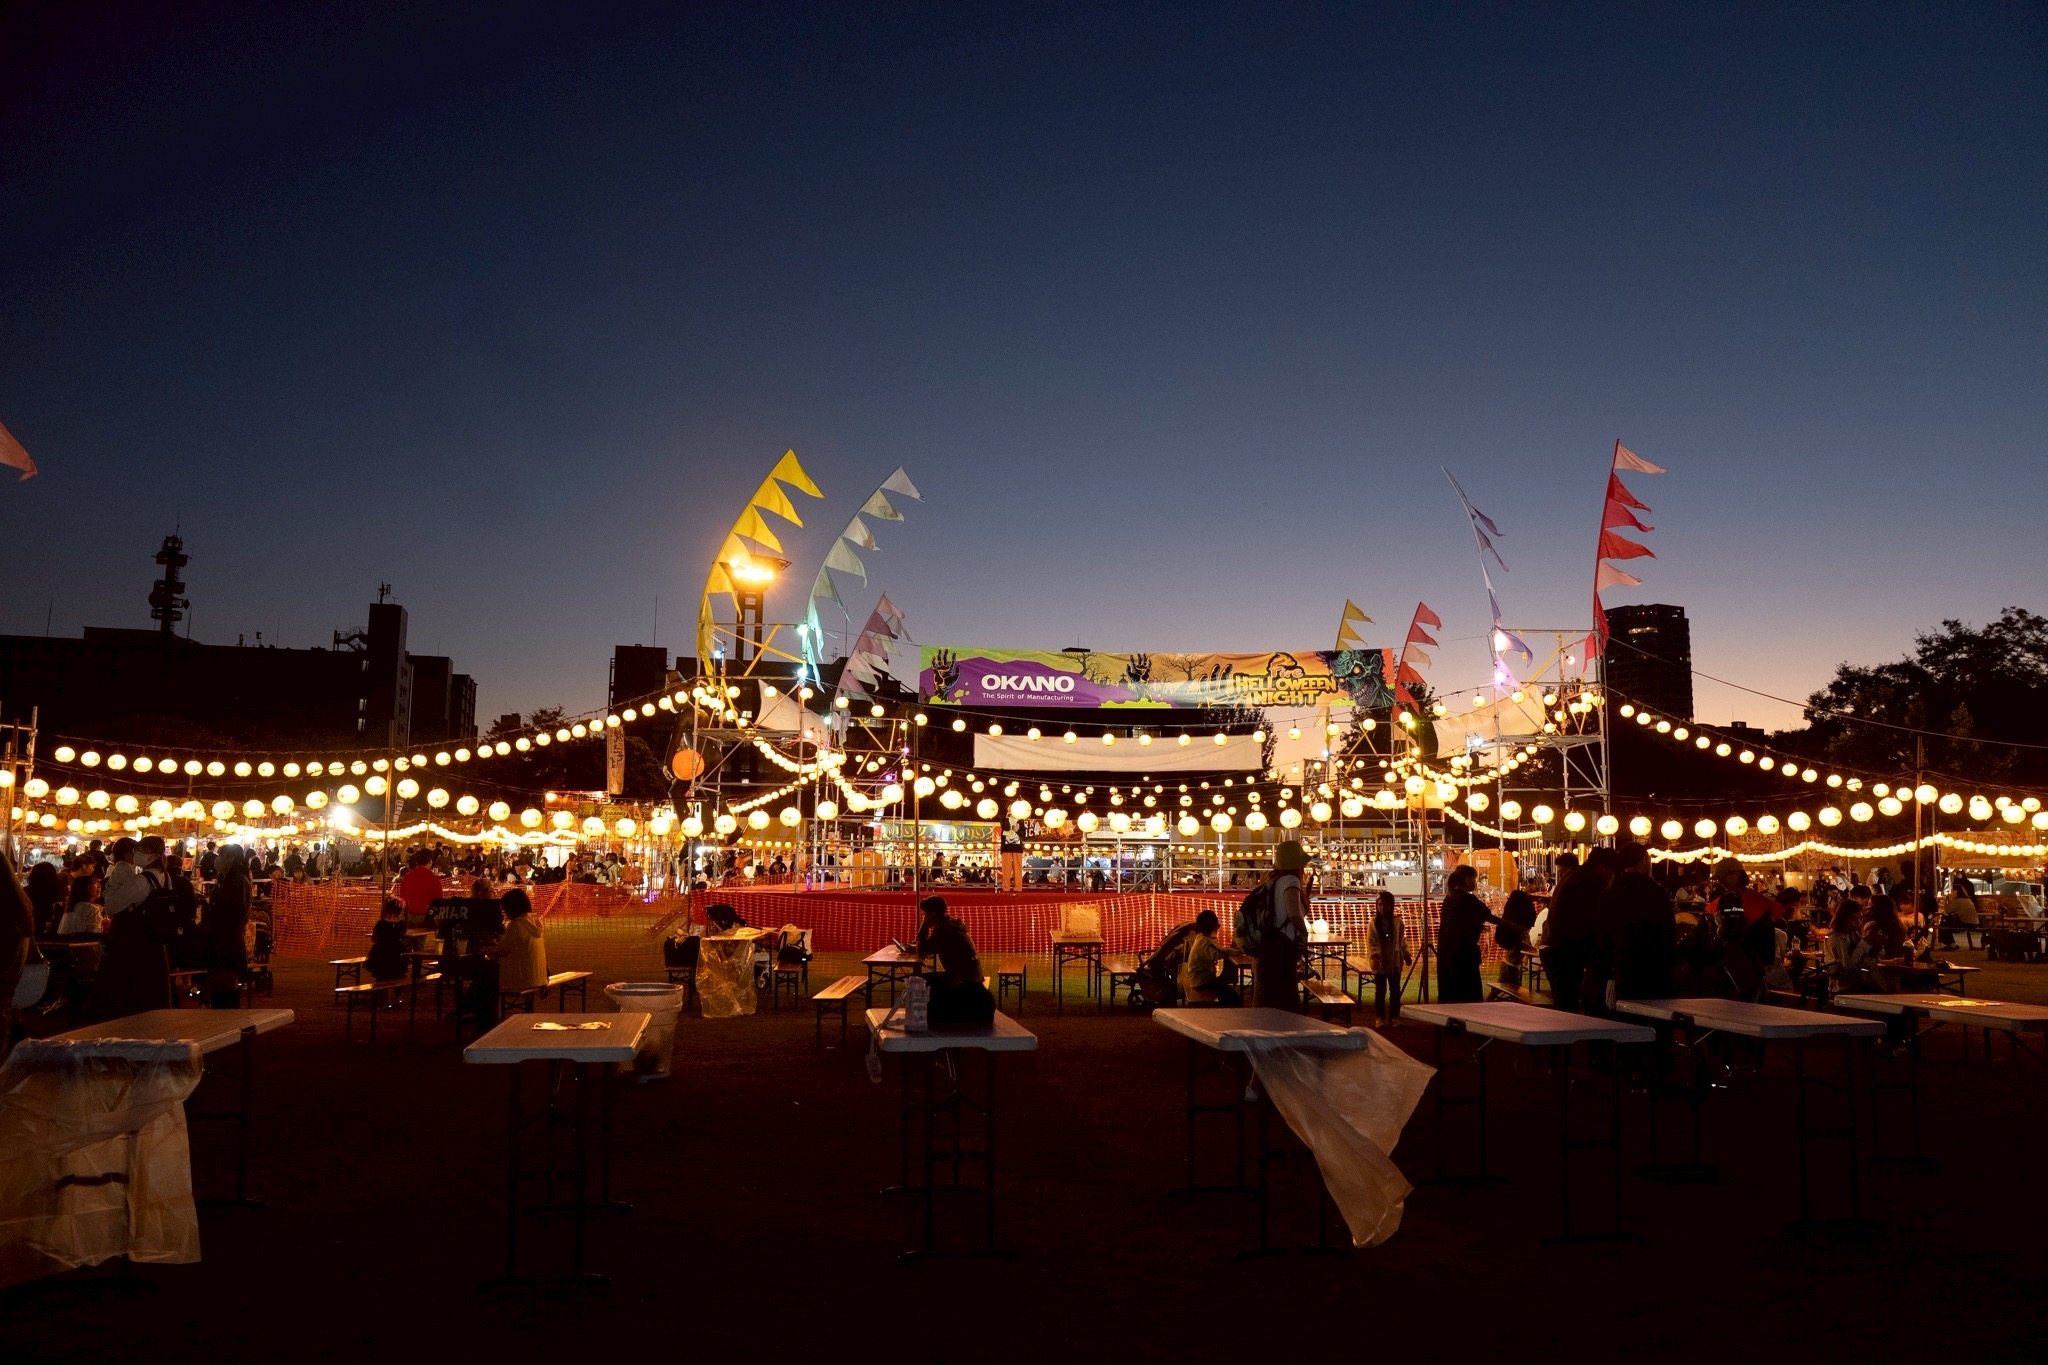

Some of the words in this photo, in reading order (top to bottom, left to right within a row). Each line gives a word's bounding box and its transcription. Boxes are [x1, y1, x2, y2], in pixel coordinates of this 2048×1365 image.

[1269, 658, 1304, 678] Fire
[981, 674, 1075, 692] OKANO
[1026, 694, 1074, 702] Manufacturing
[1251, 690, 1320, 705] NIGHT
